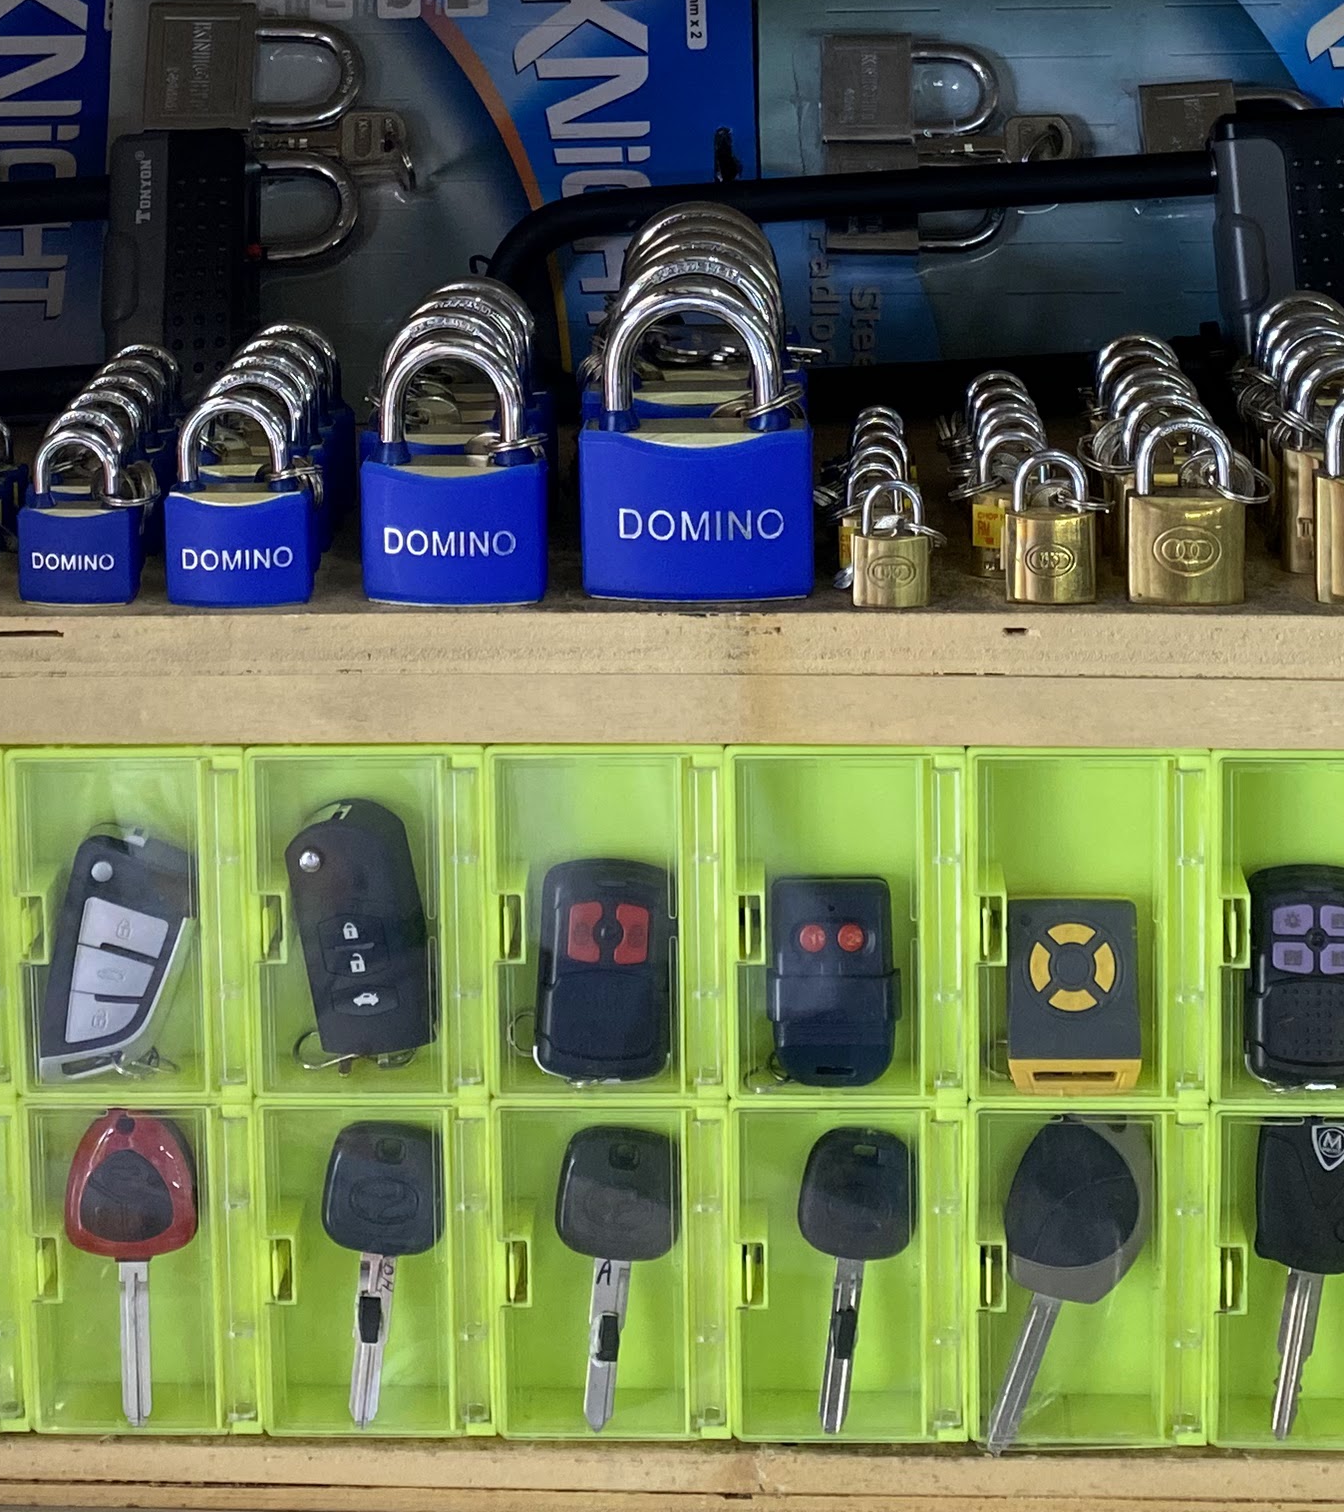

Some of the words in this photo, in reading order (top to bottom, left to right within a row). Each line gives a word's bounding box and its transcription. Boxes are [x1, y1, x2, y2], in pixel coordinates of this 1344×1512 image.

[690, 19, 699, 28] x
[135, 159, 152, 224] TONYON
[618, 508, 784, 542] DOMINO
[384, 527, 517, 557] DOMINO
[32, 552, 114, 570] DOMINO
[182, 546, 294, 571] DOMINO
